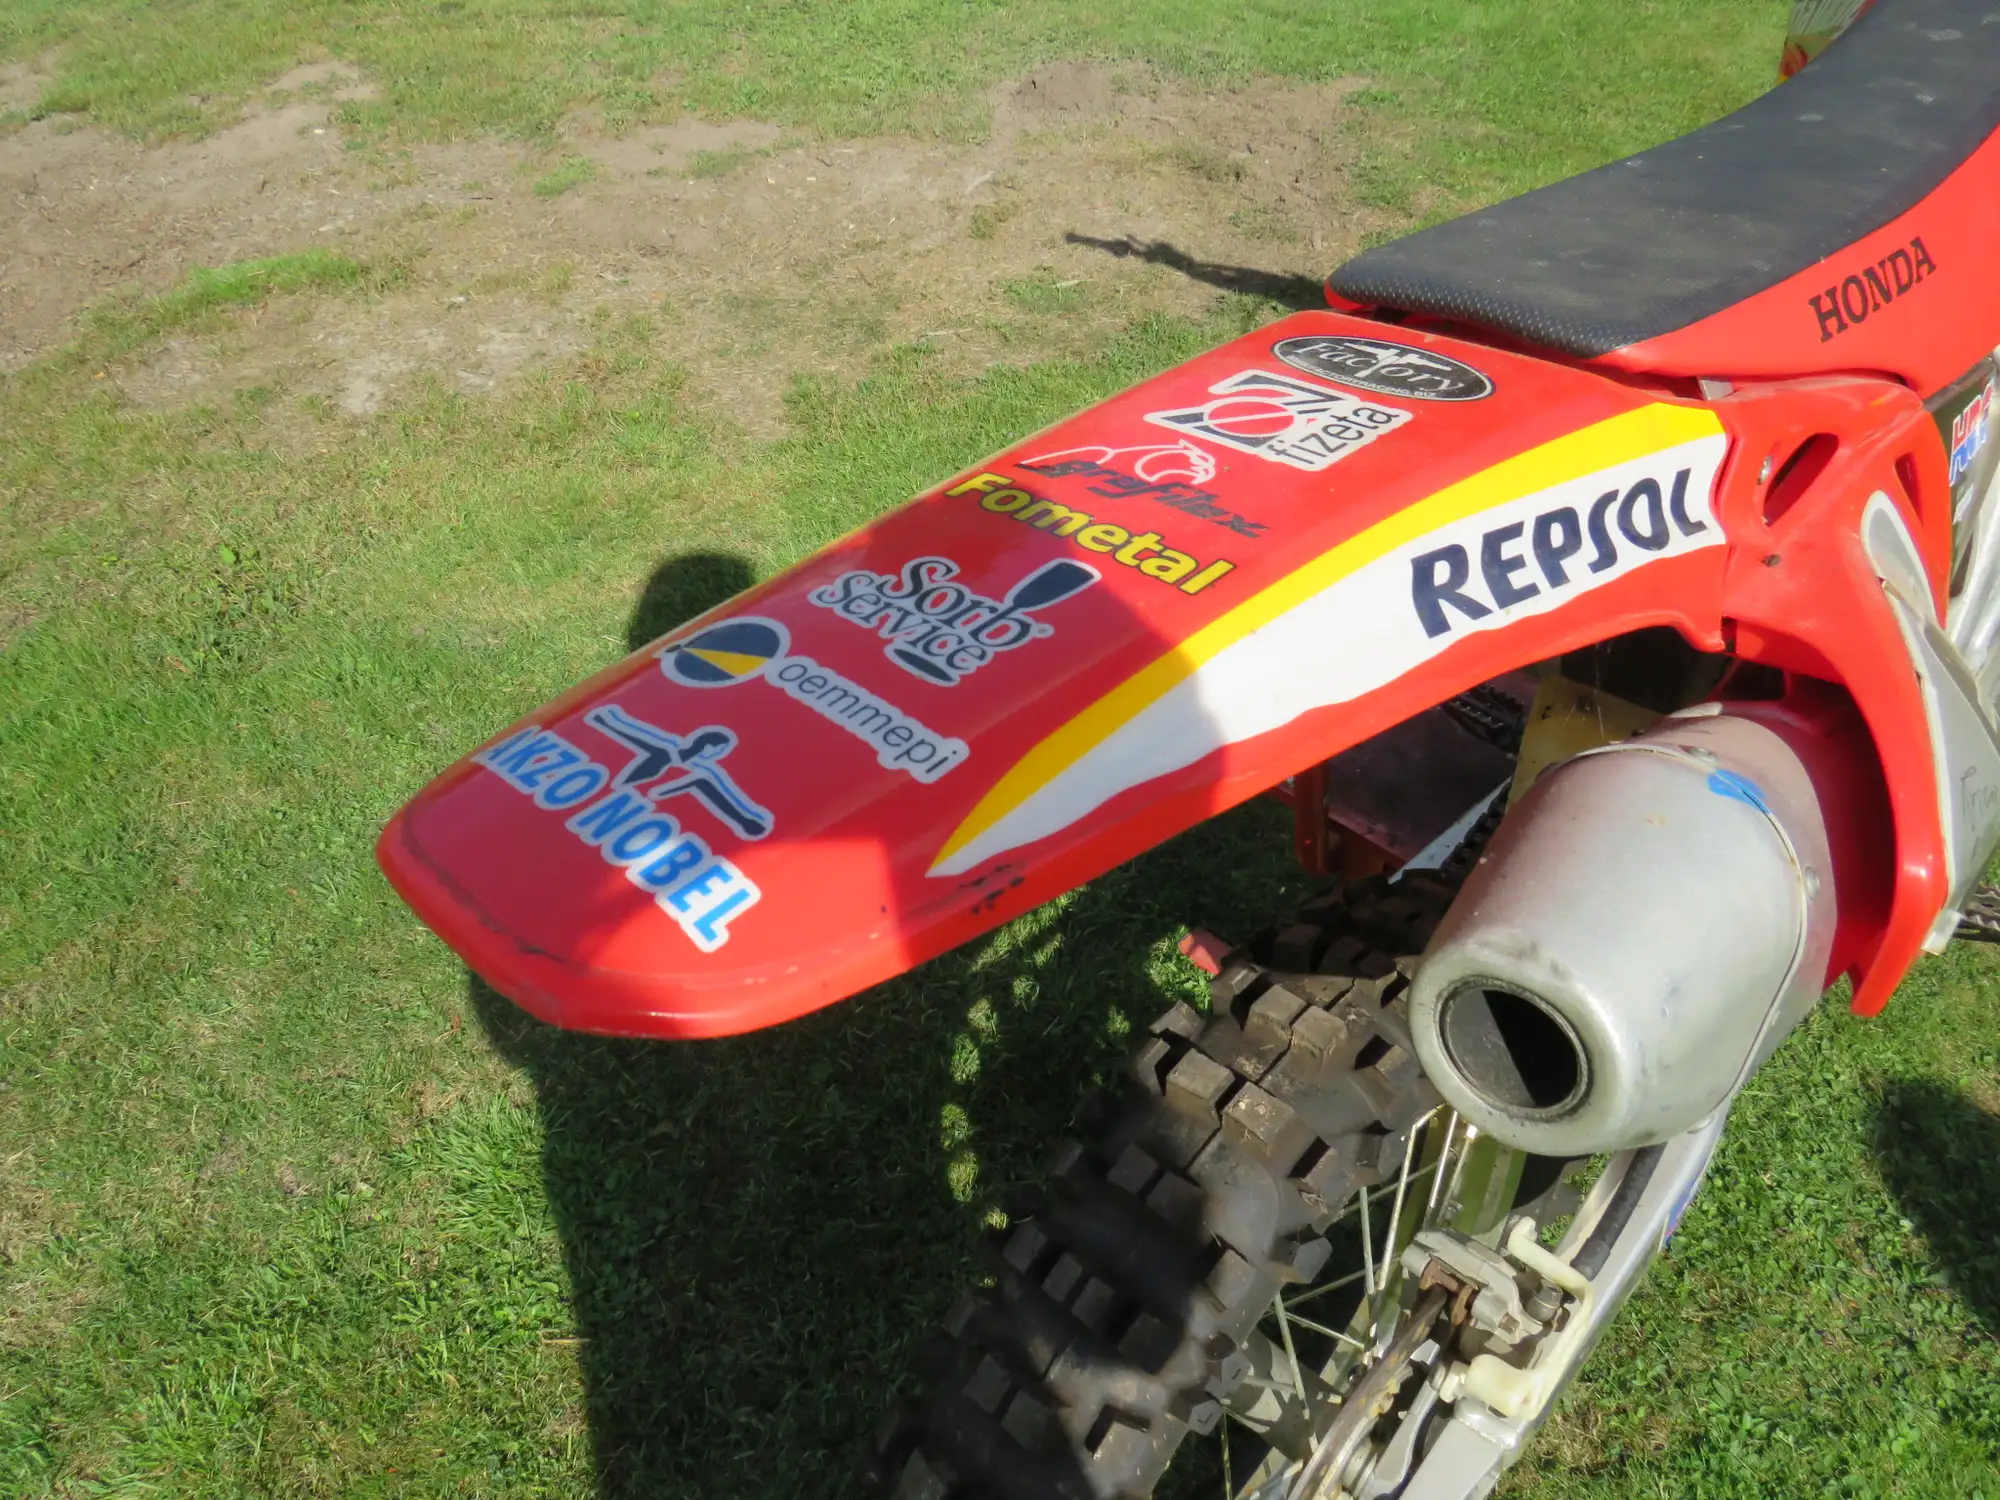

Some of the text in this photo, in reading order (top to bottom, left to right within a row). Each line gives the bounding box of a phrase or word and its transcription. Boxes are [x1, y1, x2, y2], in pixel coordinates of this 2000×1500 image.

[1808, 236, 1937, 343] HONDA
[1267, 407, 1399, 464] fizeta
[945, 472, 1237, 596] Fometal
[1410, 468, 1708, 639] REPSOL
[876, 560, 1094, 647] Sorb
[778, 663, 958, 774] oemmepi
[577, 793, 751, 942] NOBEL
